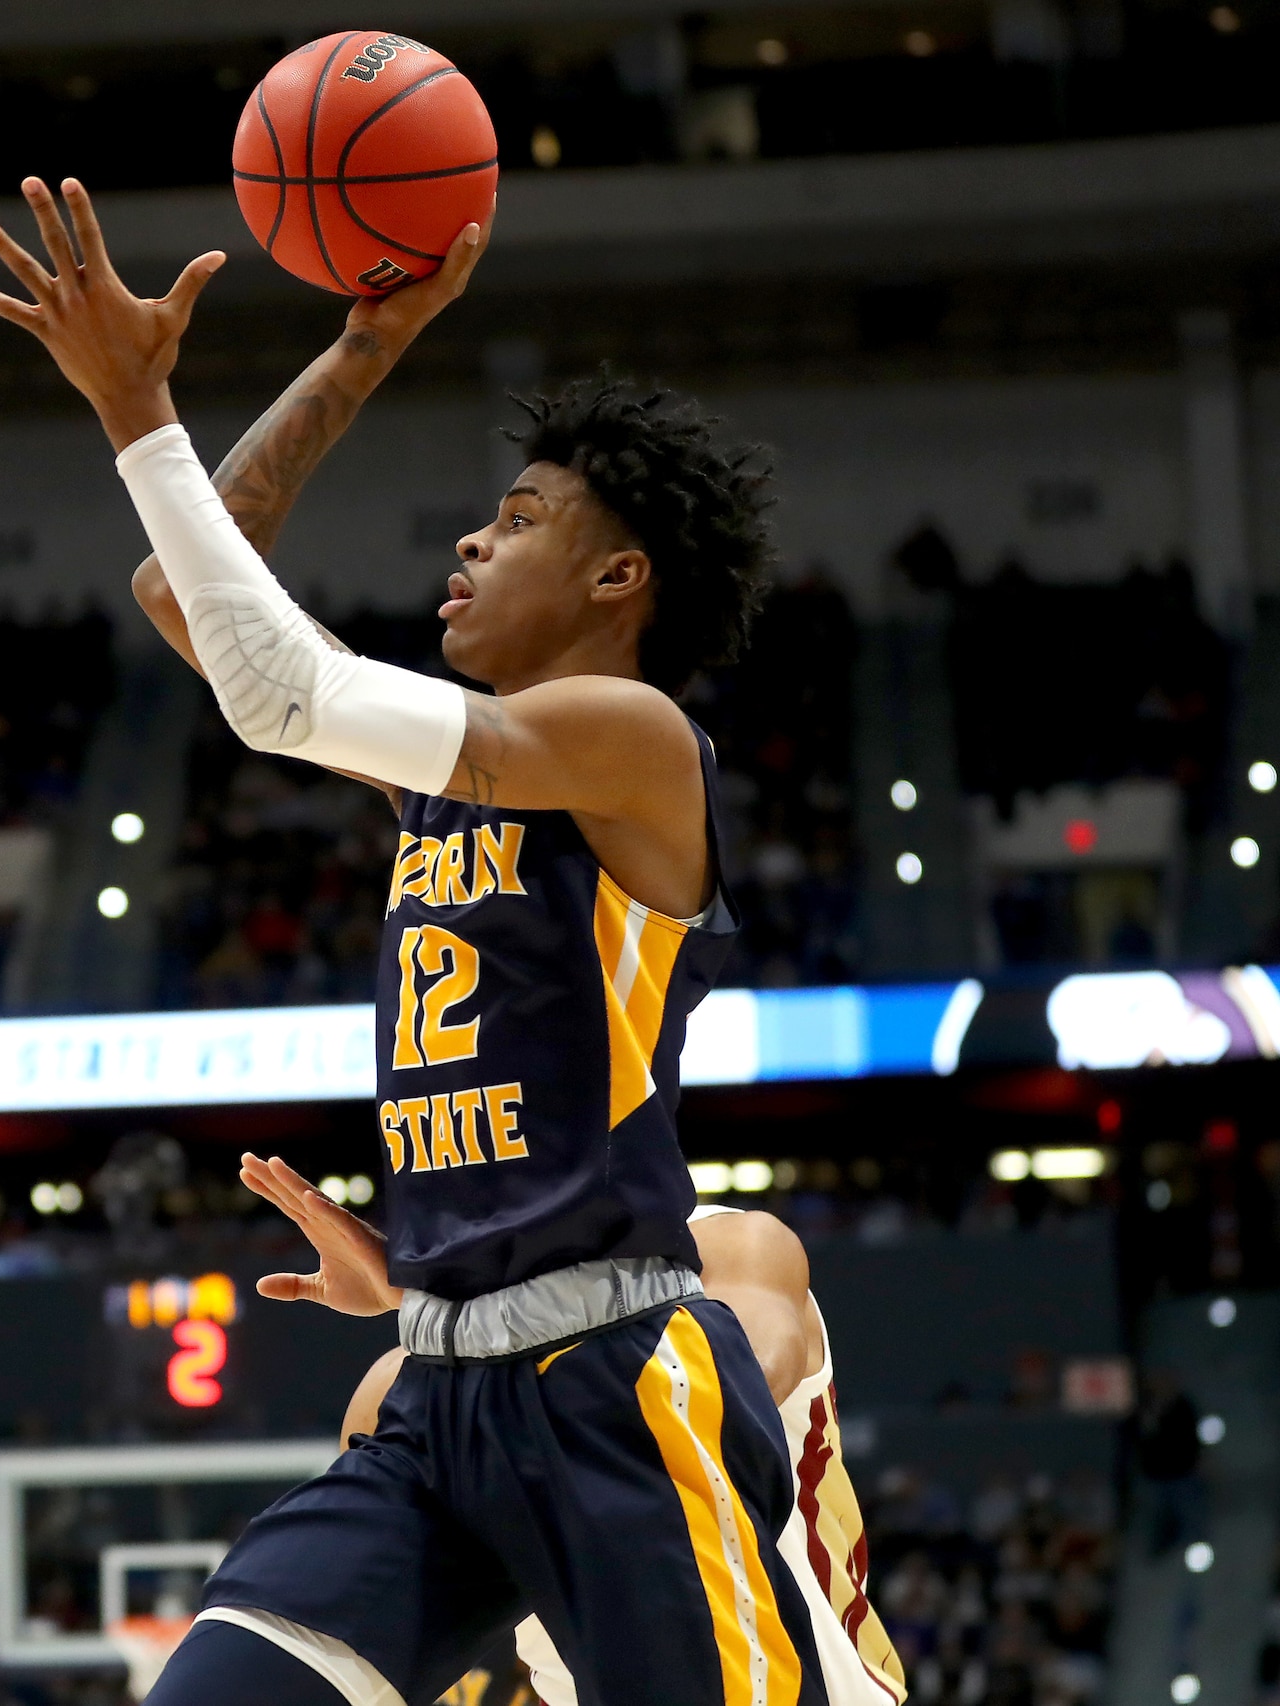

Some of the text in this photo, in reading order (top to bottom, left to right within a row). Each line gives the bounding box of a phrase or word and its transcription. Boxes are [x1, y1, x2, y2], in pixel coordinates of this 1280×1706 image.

[392, 924, 481, 1071] 12
[18, 1035, 162, 1086] STATE
[196, 1030, 256, 1079] VS
[379, 1081, 530, 1174] STATE
[167, 1319, 227, 1407] 2
